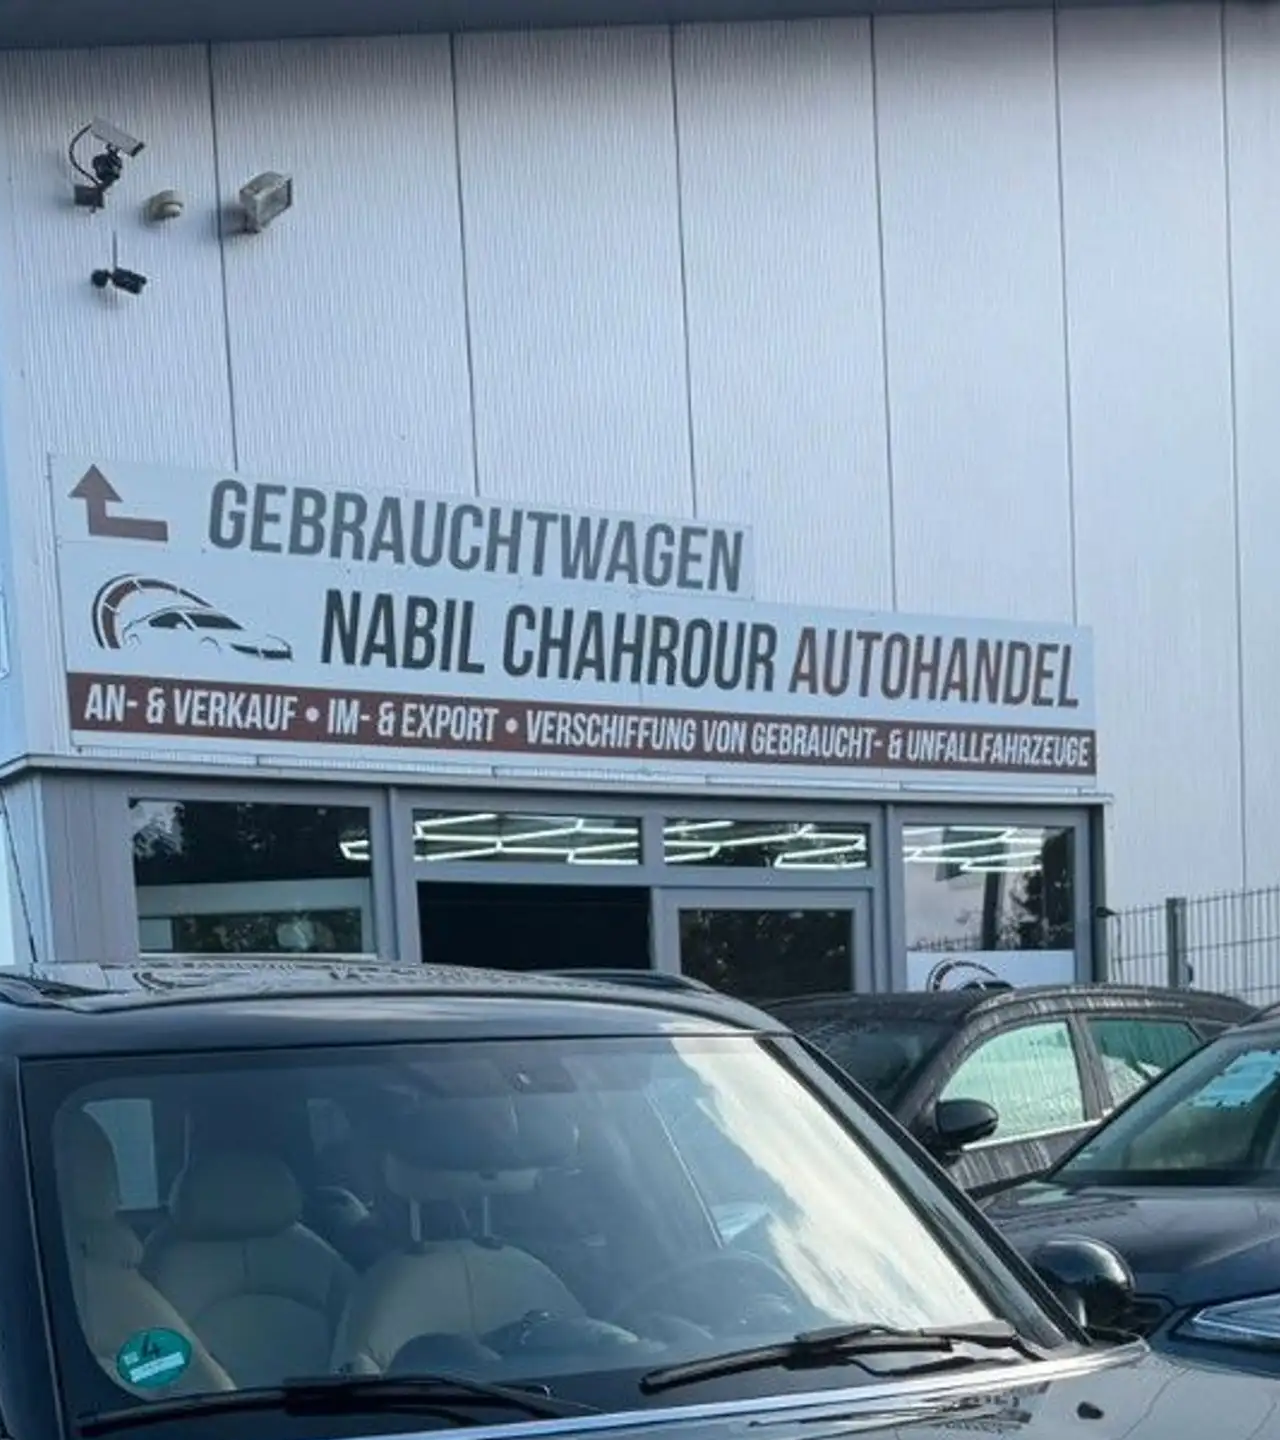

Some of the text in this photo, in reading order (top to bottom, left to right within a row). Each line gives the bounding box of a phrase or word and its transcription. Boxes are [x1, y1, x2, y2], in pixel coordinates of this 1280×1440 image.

[209, 478, 744, 593] GEBRAUCHTWAGEN
[320, 587, 1080, 709] NABIL CHAHROUR AUTOHANDEL
[84, 684, 1092, 768] AN- & VERKAUF IM- & EXPORT VERSCHIFFUNG VON GEBRAUCHT- & UNFALLFAHRZEUGE
